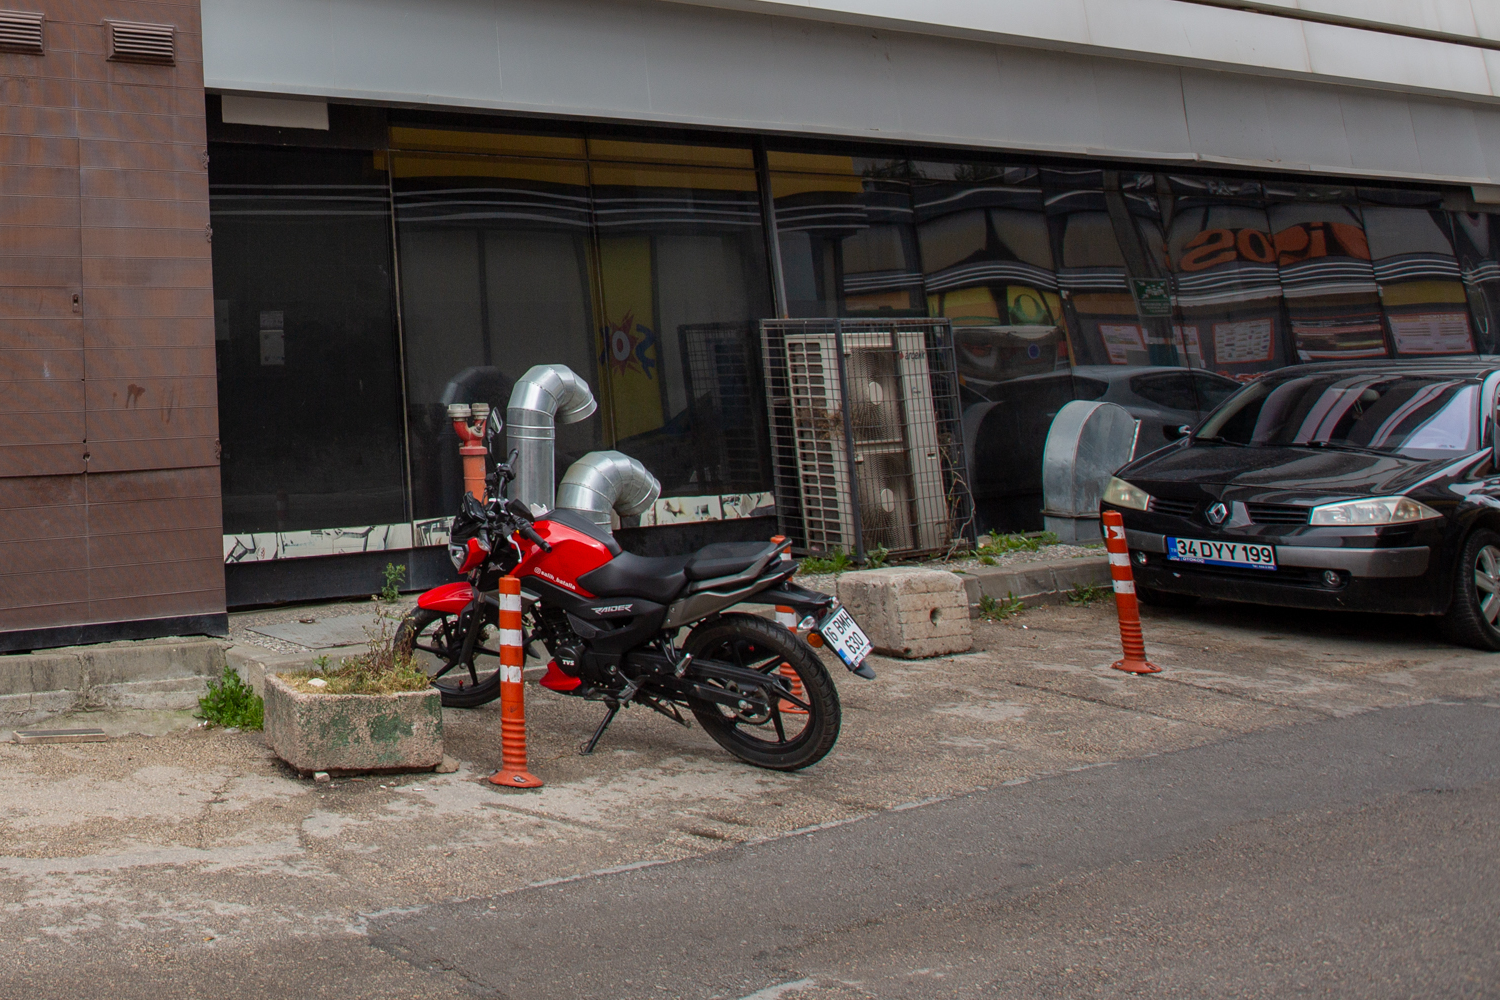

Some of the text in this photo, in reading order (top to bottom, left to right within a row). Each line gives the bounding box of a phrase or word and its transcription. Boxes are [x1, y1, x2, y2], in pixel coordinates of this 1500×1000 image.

[1177, 540, 1197, 557] 34
[1199, 542, 1237, 560] DYY
[1241, 545, 1273, 563] 199
[591, 603, 633, 615] RAIDER
[824, 626, 839, 644] 16
[832, 610, 854, 635] BMH
[844, 631, 864, 654] 630
